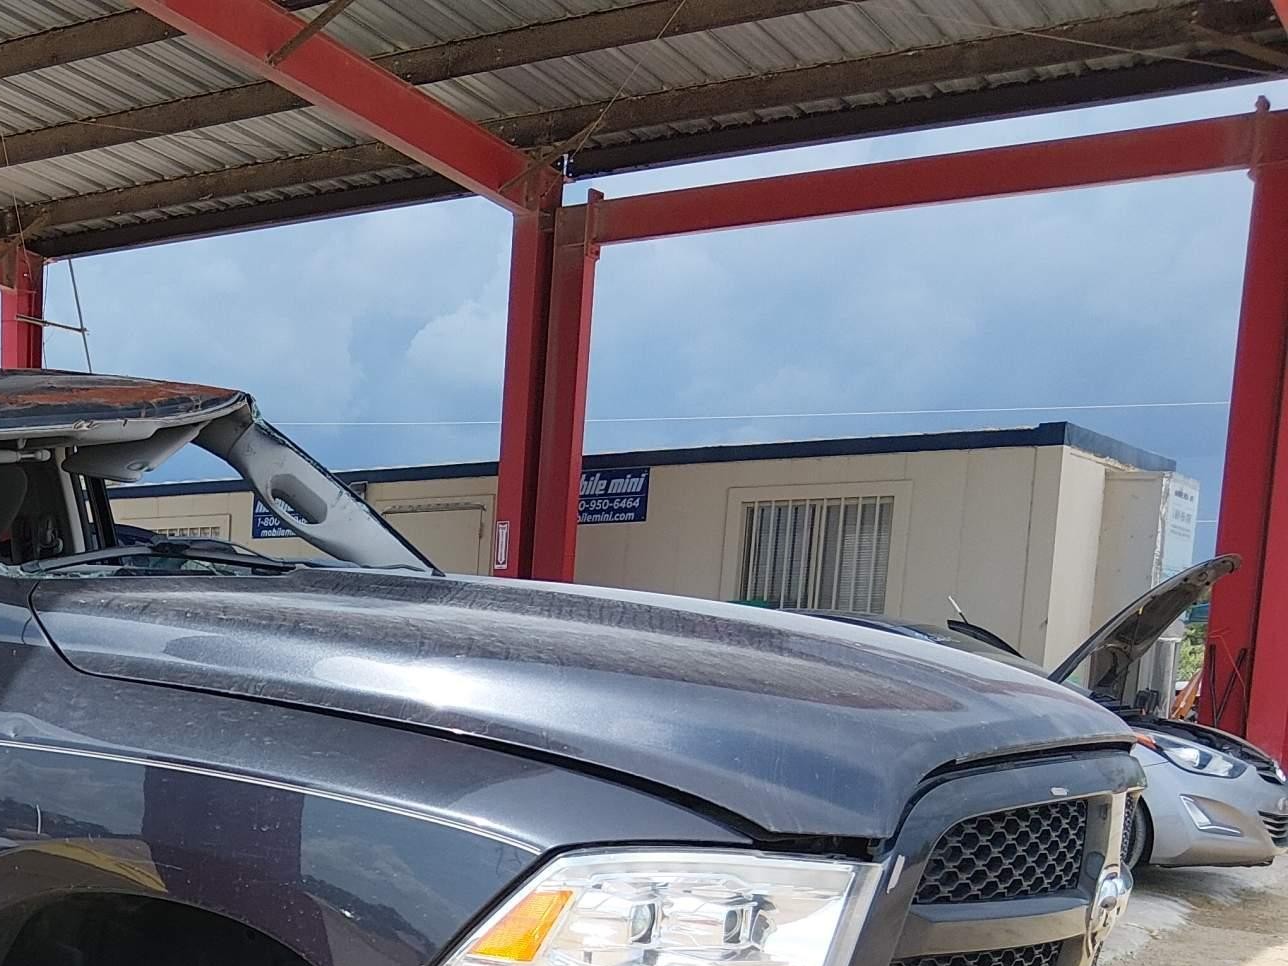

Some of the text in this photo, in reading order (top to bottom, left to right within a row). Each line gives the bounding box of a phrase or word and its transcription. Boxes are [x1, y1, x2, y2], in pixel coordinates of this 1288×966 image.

[579, 473, 645, 495] bile mini
[578, 498, 640, 511] 0-950-6464
[577, 512, 634, 523] bilemini.com
